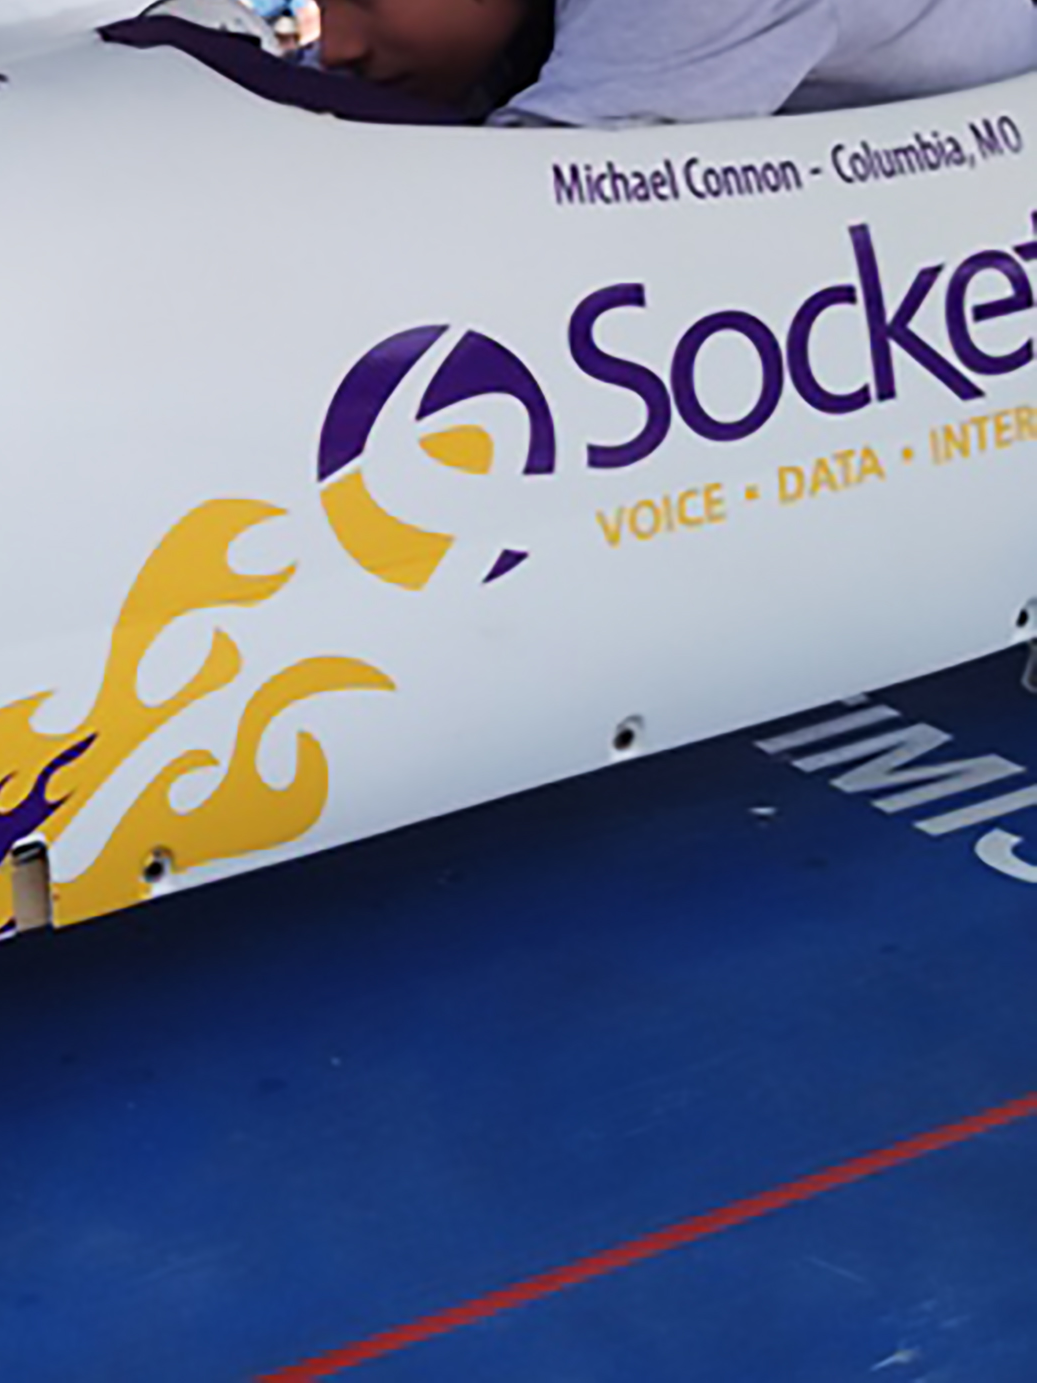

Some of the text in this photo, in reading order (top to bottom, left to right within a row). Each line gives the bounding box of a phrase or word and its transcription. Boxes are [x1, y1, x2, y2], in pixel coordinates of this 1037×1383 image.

[553, 159, 678, 205] Michael
[684, 157, 803, 199] Connon
[831, 129, 977, 183] Columbia,
[969, 115, 1024, 161] MO
[595, 483, 726, 549] VOICE
[777, 445, 886, 505] DATA
